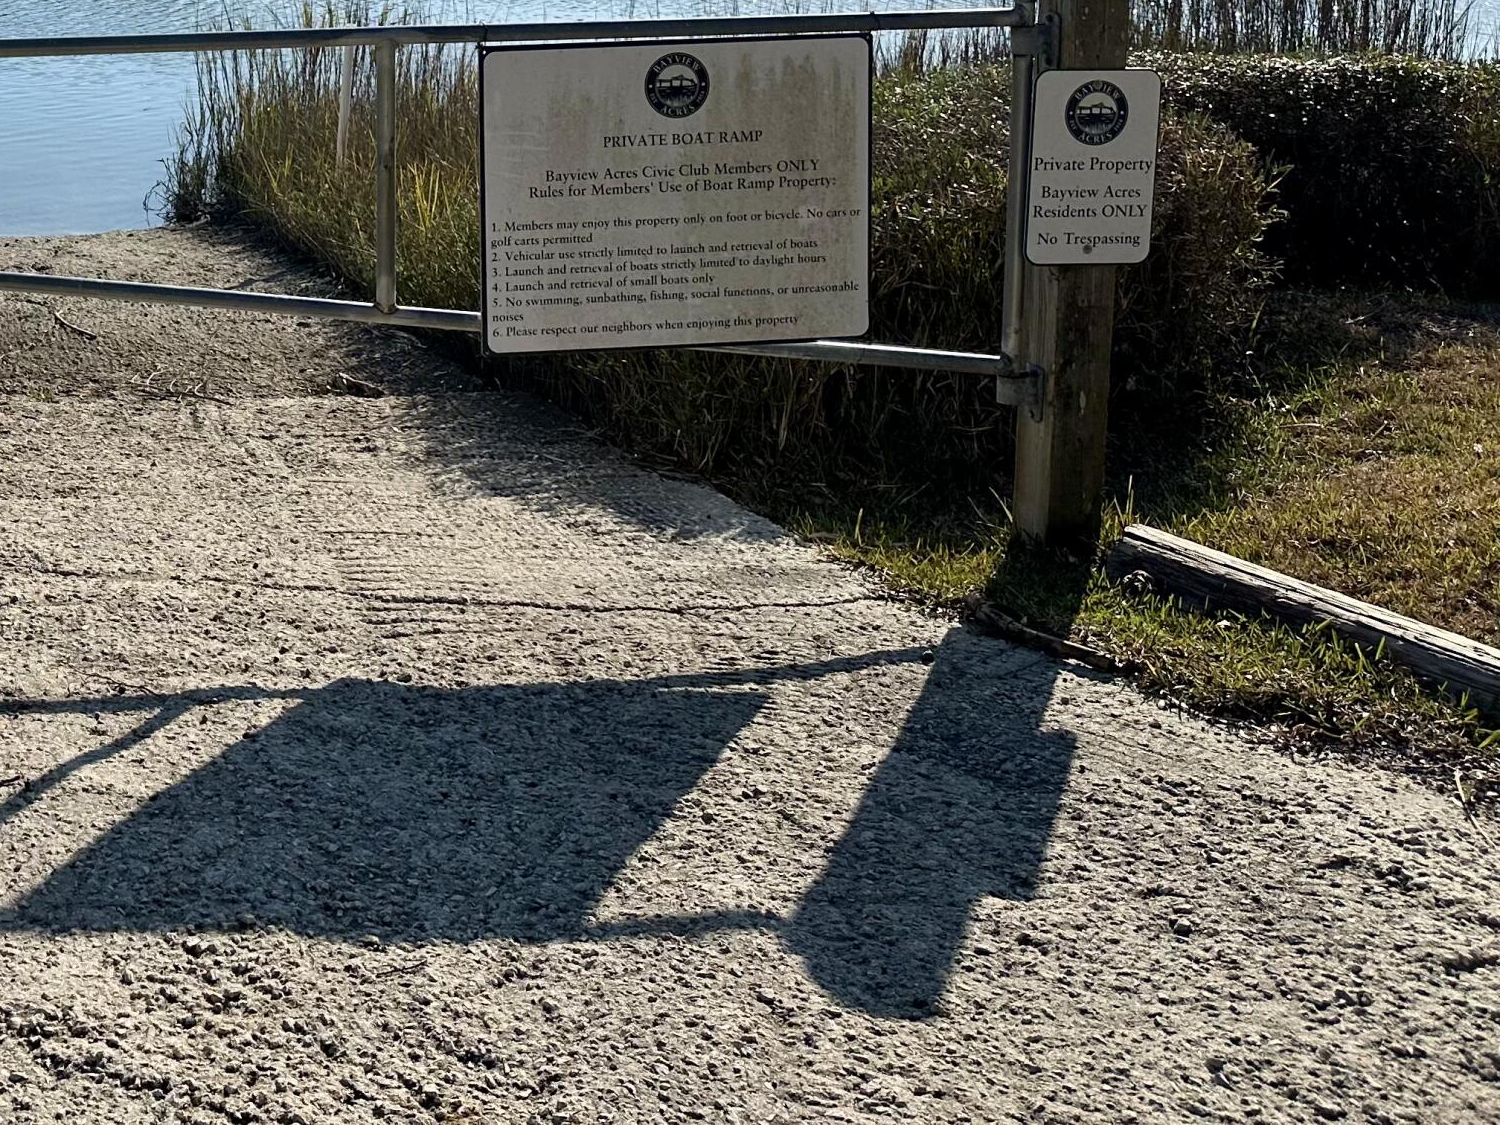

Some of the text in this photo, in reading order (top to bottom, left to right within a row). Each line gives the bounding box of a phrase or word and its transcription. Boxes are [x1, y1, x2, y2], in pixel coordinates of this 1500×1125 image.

[653, 55, 700, 73] BAYVIEW
[1075, 83, 1121, 100] BAYIEW
[660, 105, 696, 116] ACRES
[603, 130, 763, 148] PRIVATE BOAT RAMP
[1078, 131, 1113, 144] ACRES
[546, 159, 820, 184] Bayview Acres Civic Club Members ONLY
[1034, 157, 1153, 174] Private Property
[529, 176, 836, 198] Rules for Members' Use of Boat Ramp Property:
[1041, 185, 1141, 202] Bayview Acres
[504, 220, 553, 232] Members
[556, 221, 579, 232] may
[582, 219, 610, 230] enjoy
[613, 217, 632, 227] this
[635, 217, 679, 229] property
[683, 213, 705, 226] only
[709, 215, 723, 223] on
[726, 212, 748, 222] foot
[751, 213, 762, 221] or
[806, 208, 823, 219] No
[826, 210, 847, 218] cars
[850, 209, 861, 217] or
[1033, 204, 1147, 218] Residents ONLY
[490, 233, 593, 249] golf carts permitted
[1037, 232, 1141, 247] No Trespassing
[505, 250, 555, 261] Vehicular
[558, 251, 575, 260] use
[578, 247, 613, 259] strictly
[617, 245, 653, 257] limited
[656, 246, 667, 255] to
[671, 243, 704, 254] launch
[708, 242, 727, 252] and
[731, 240, 773, 251] retrieval
[776, 238, 788, 249] of
[790, 238, 818, 248] boats
[505, 266, 544, 277] Launch
[547, 265, 566, 275] and
[570, 262, 613, 274] retrieval
[616, 261, 628, 272] of
[630, 261, 658, 271] boats
[661, 258, 696, 270] strictly
[700, 257, 736, 268] limited
[739, 257, 750, 266] to
[753, 255, 794, 267] daylight
[797, 253, 827, 263] hours
[505, 280, 544, 292] Launch
[547, 280, 567, 290] and
[570, 277, 613, 289] retrieval
[616, 276, 628, 287] of
[630, 275, 657, 286] small
[660, 275, 689, 286] boats
[692, 273, 715, 285] only
[505, 296, 523, 307] No
[586, 292, 647, 304] sunbathing,
[650, 290, 688, 302] fishing,
[691, 288, 720, 299] social
[777, 286, 788, 295] or
[791, 280, 859, 294] unreasonable
[492, 312, 524, 322] noises
[506, 326, 538, 337] Please
[541, 326, 576, 338] respect
[580, 325, 599, 334] our
[601, 321, 652, 334] neighbors
[656, 319, 683, 330] when
[686, 318, 731, 330] enjoying
[733, 316, 752, 326] this
[755, 315, 800, 328] property
